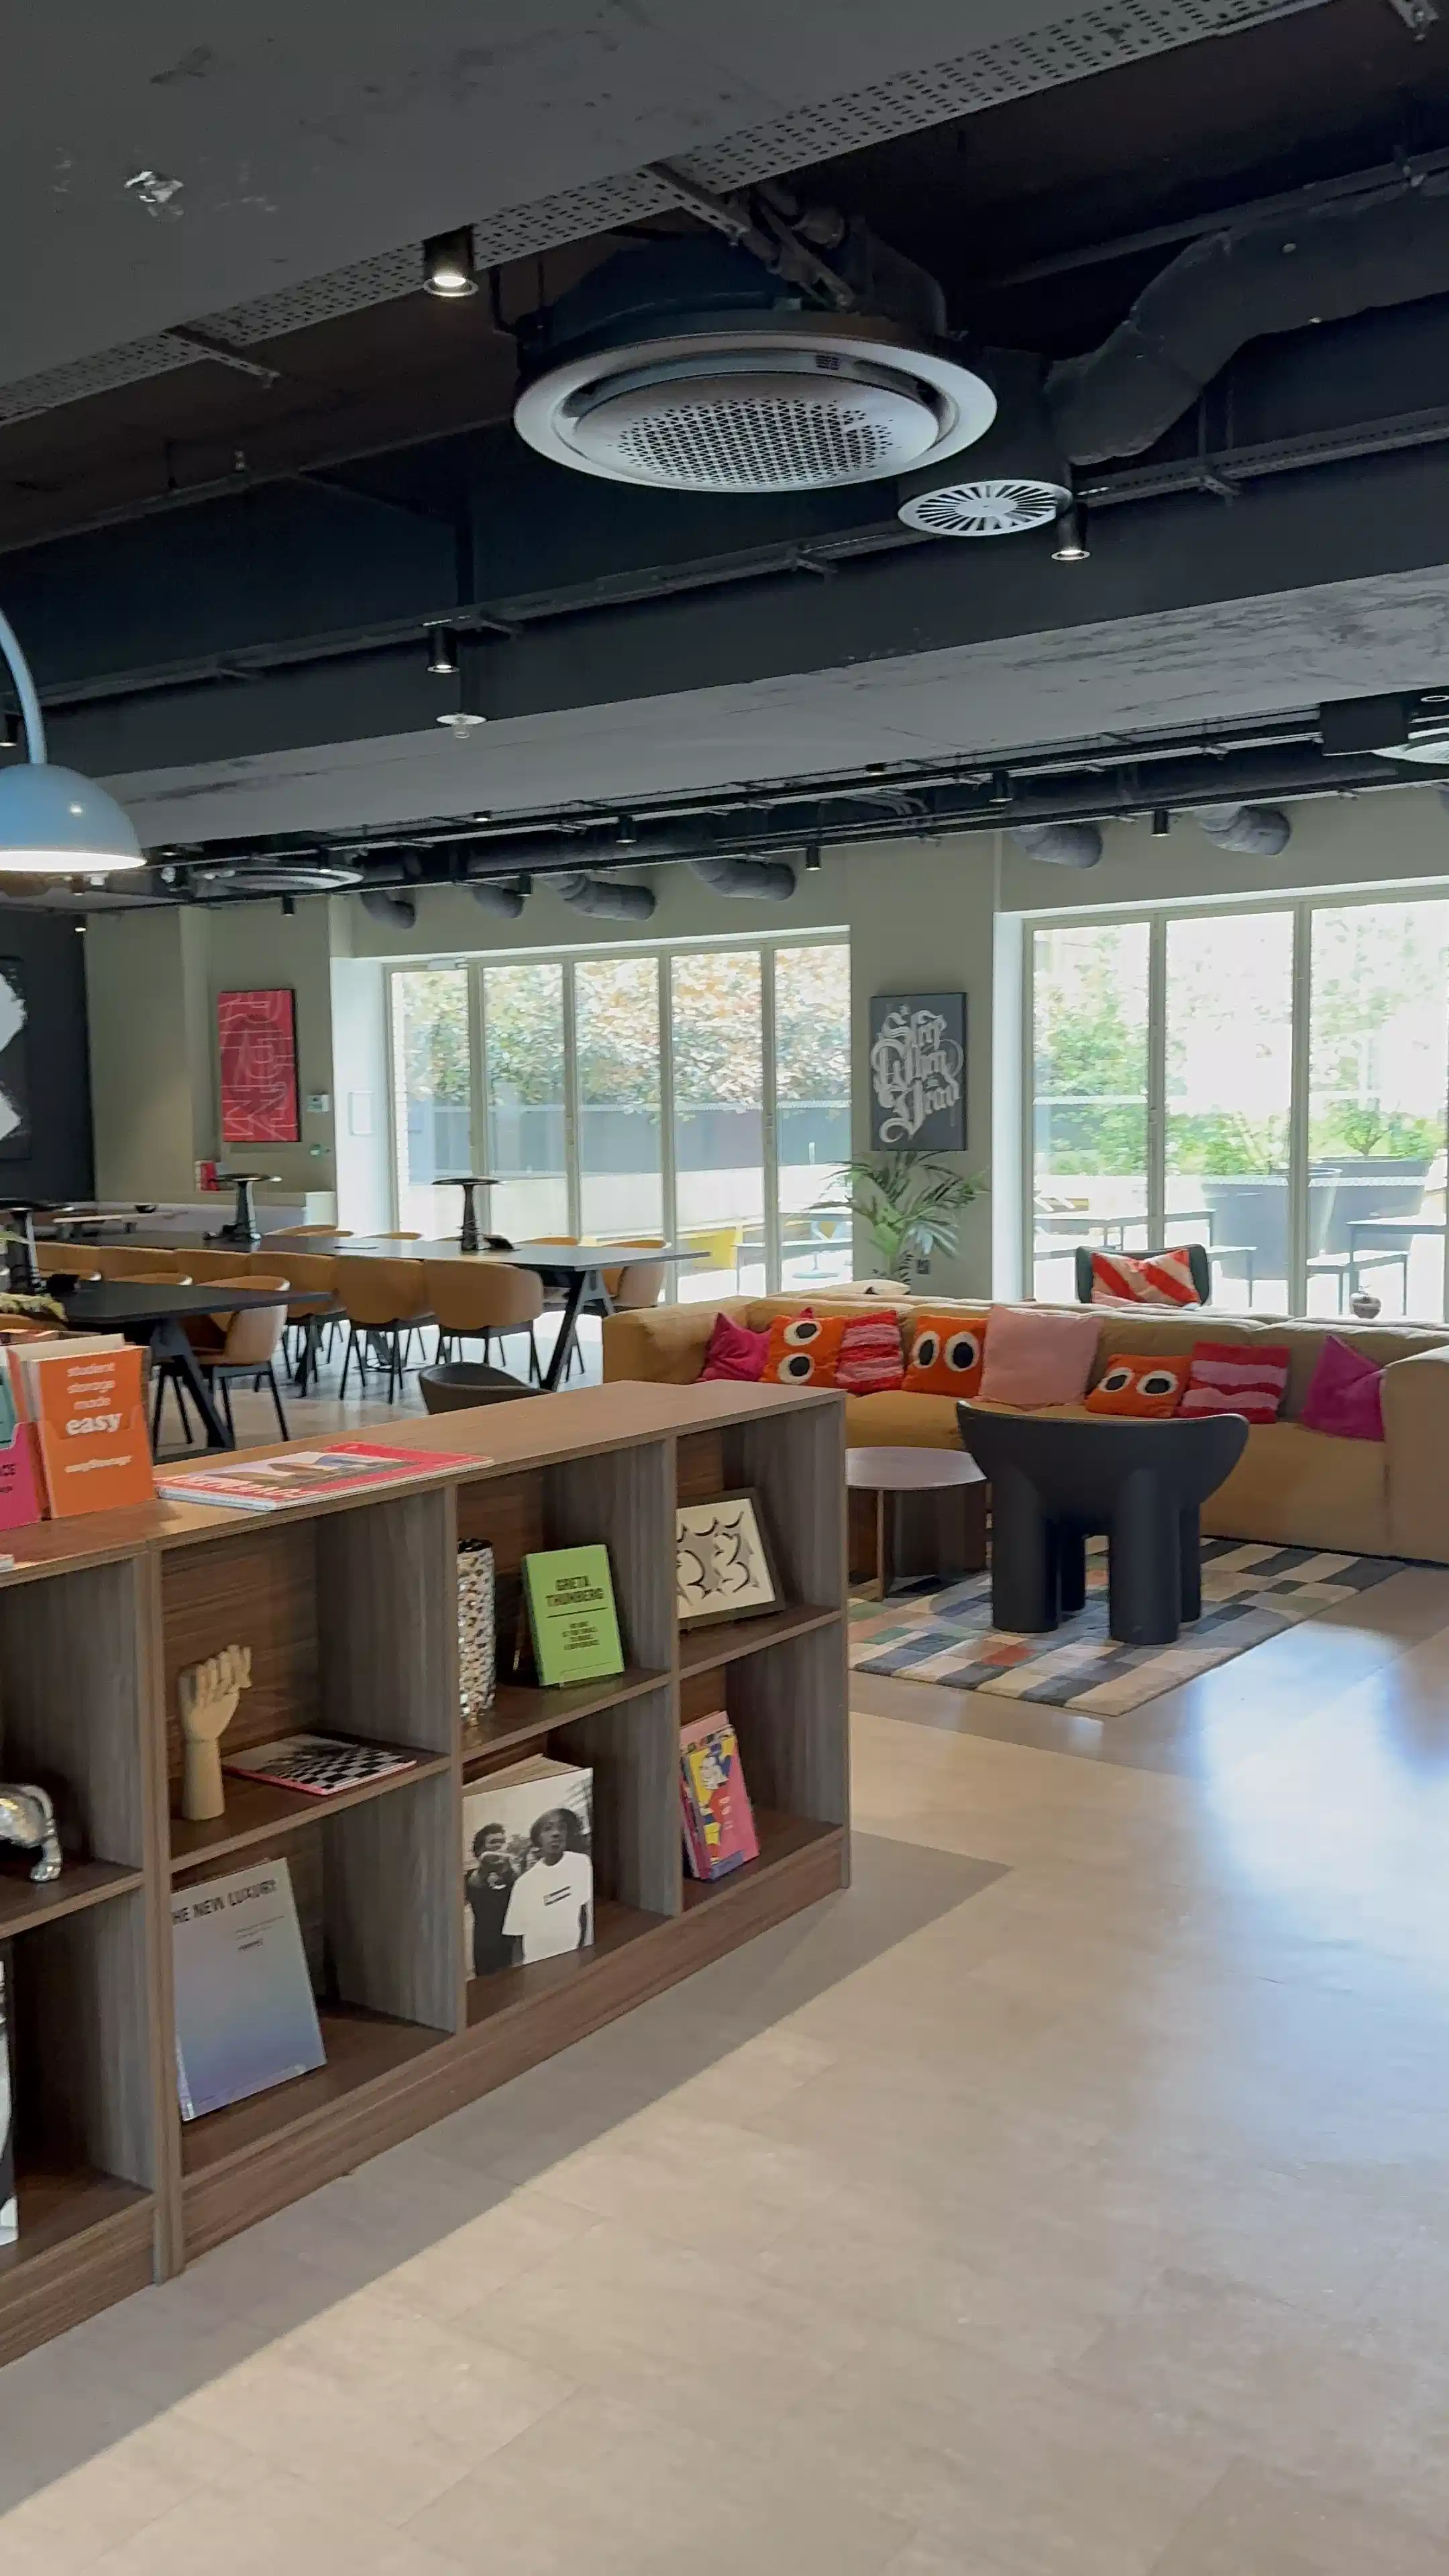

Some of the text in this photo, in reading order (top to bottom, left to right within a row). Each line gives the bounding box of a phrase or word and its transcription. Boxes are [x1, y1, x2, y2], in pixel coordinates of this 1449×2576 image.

[67, 1362, 115, 1377] student
[65, 1413, 123, 1436] easy
[555, 1575, 591, 1591] GRETA
[544, 1587, 604, 1607] THUNBERG
[171, 1907, 191, 1926] HE
[193, 1896, 226, 1918] NEW
